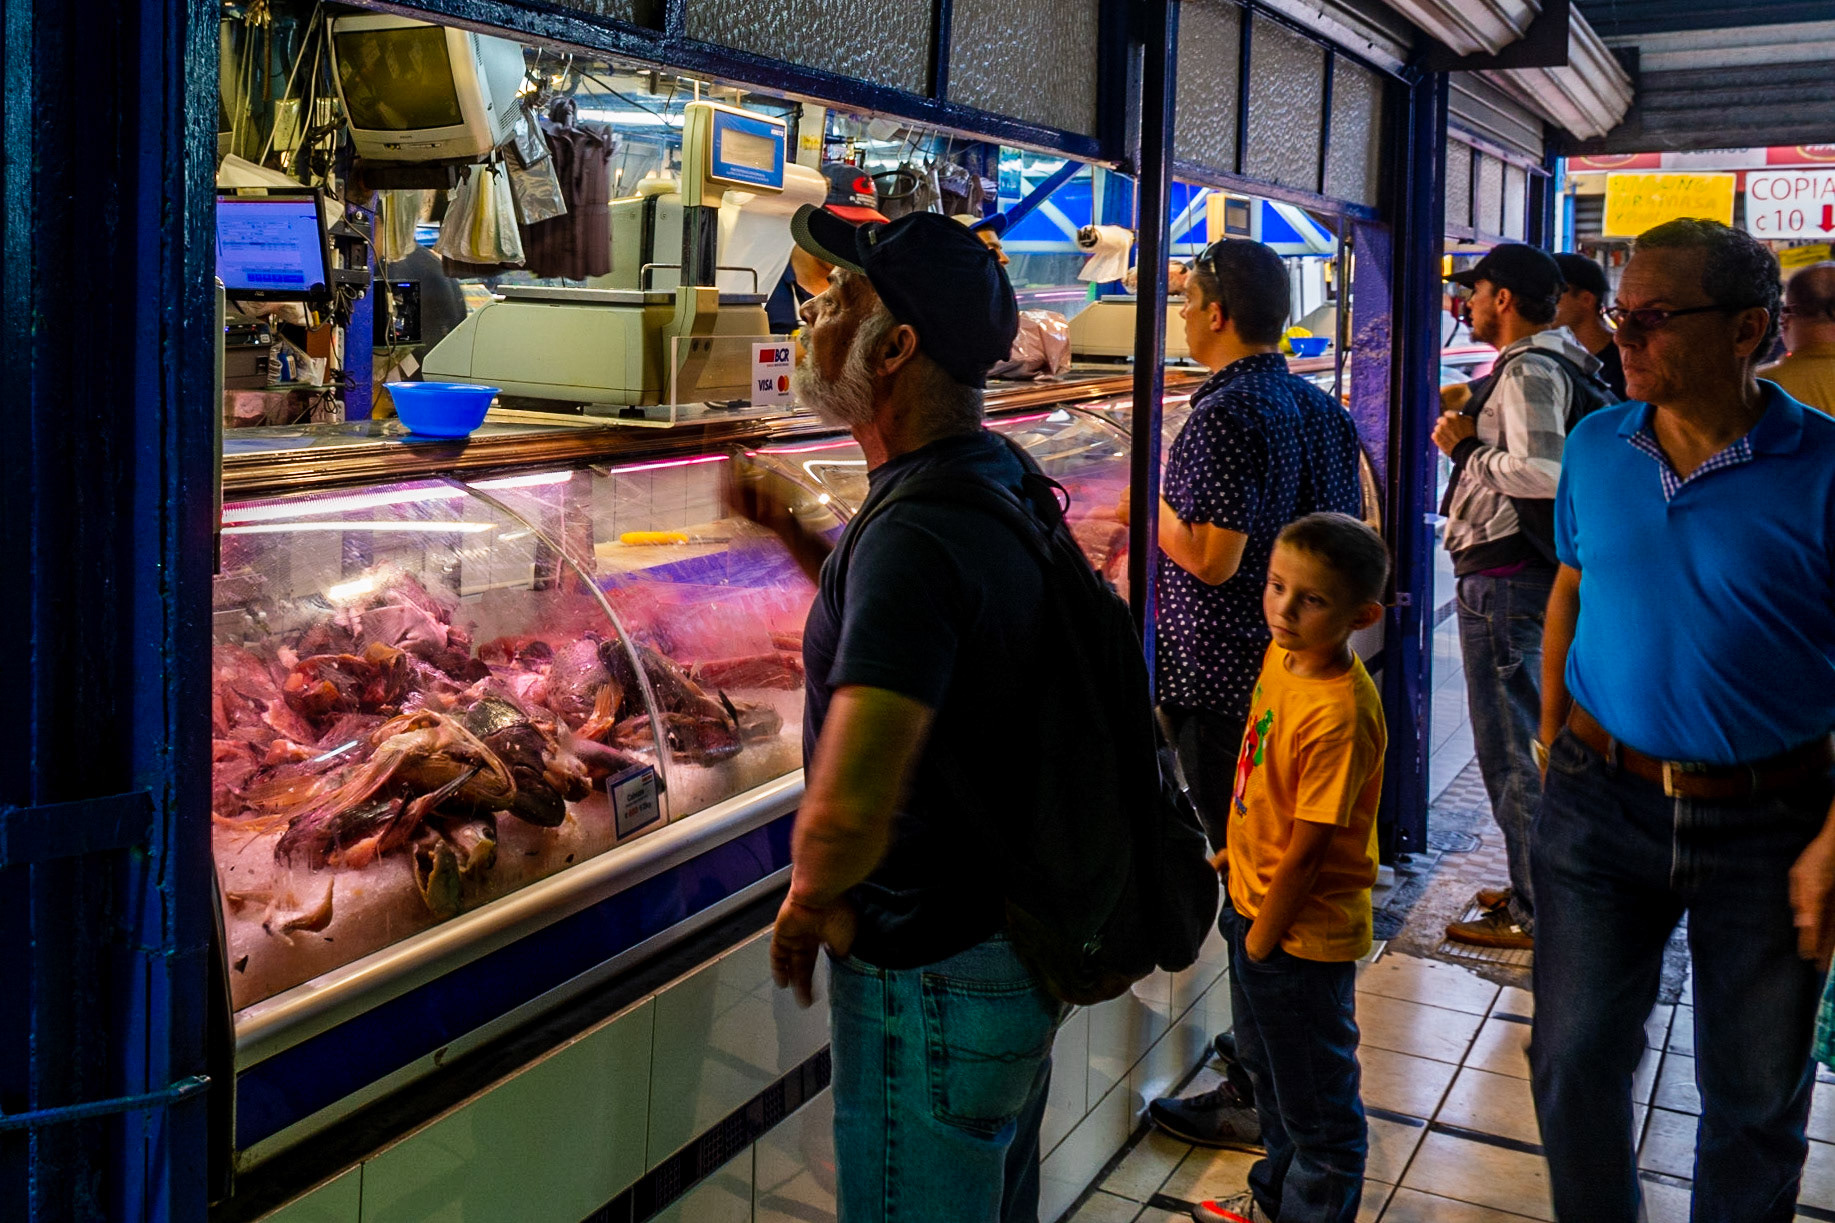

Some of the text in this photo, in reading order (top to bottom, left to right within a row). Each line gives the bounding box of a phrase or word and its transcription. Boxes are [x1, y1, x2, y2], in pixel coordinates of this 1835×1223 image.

[1774, 209, 1804, 231] 10
[775, 348, 790, 362] BCR
[758, 379, 773, 391] VISA
